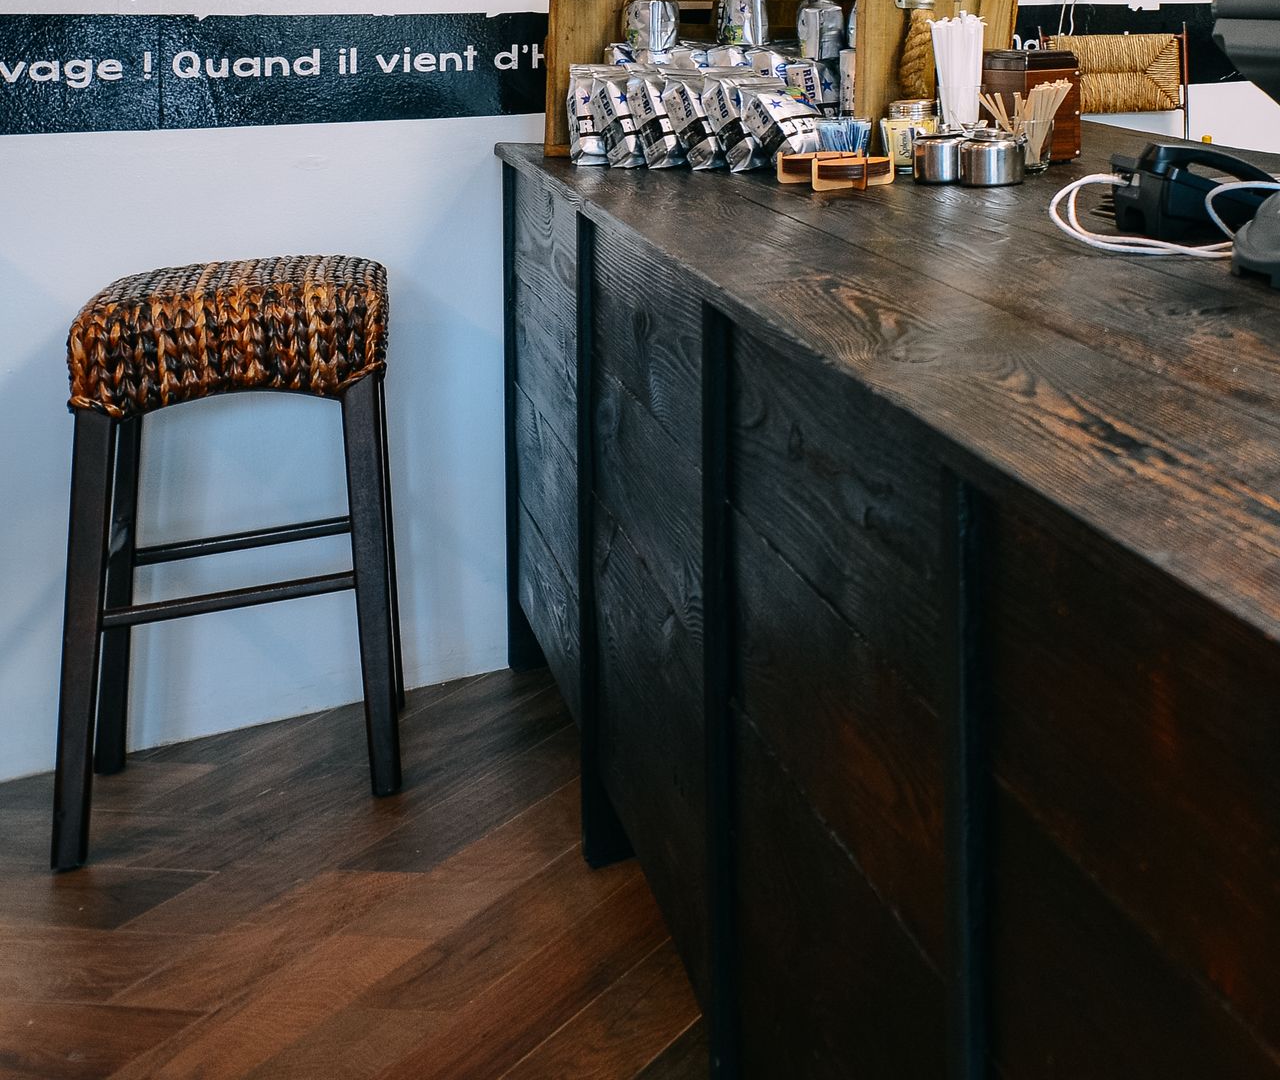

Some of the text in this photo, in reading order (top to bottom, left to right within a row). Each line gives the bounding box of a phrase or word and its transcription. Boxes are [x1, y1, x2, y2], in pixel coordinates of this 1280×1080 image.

[172, 49, 320, 78] Quand
[339, 48, 357, 74] il
[376, 45, 477, 73] vient
